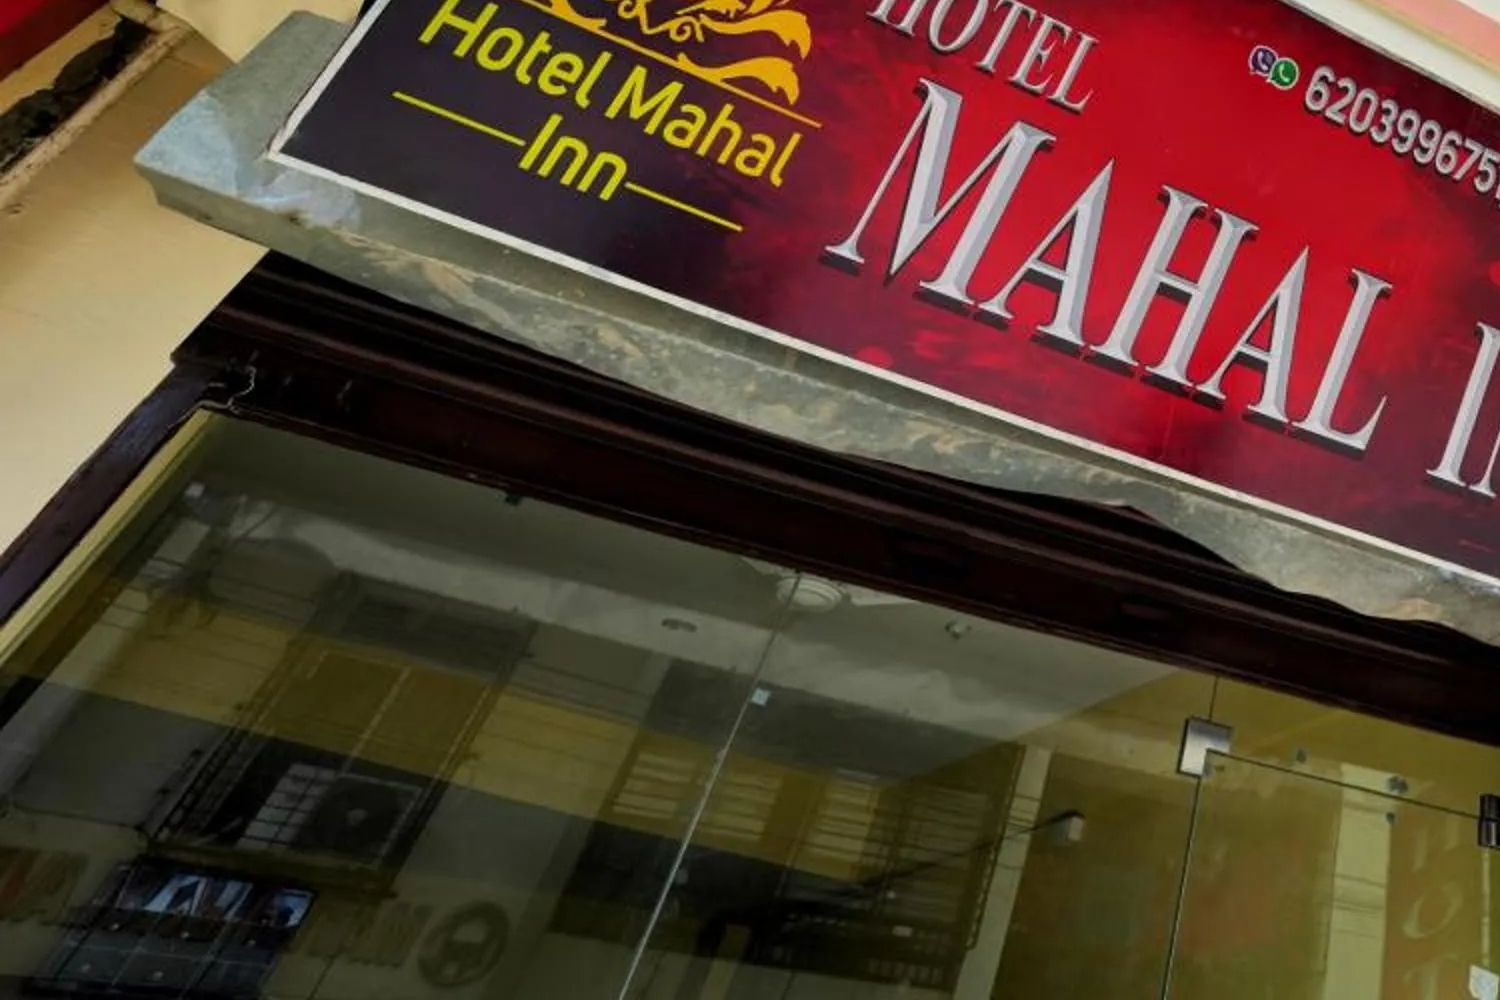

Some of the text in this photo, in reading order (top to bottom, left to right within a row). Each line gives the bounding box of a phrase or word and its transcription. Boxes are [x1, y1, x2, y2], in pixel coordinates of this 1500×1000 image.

[518, 113, 628, 201] Inn
[604, 64, 802, 188] Mahal
[823, 78, 1393, 452] MAHAL
